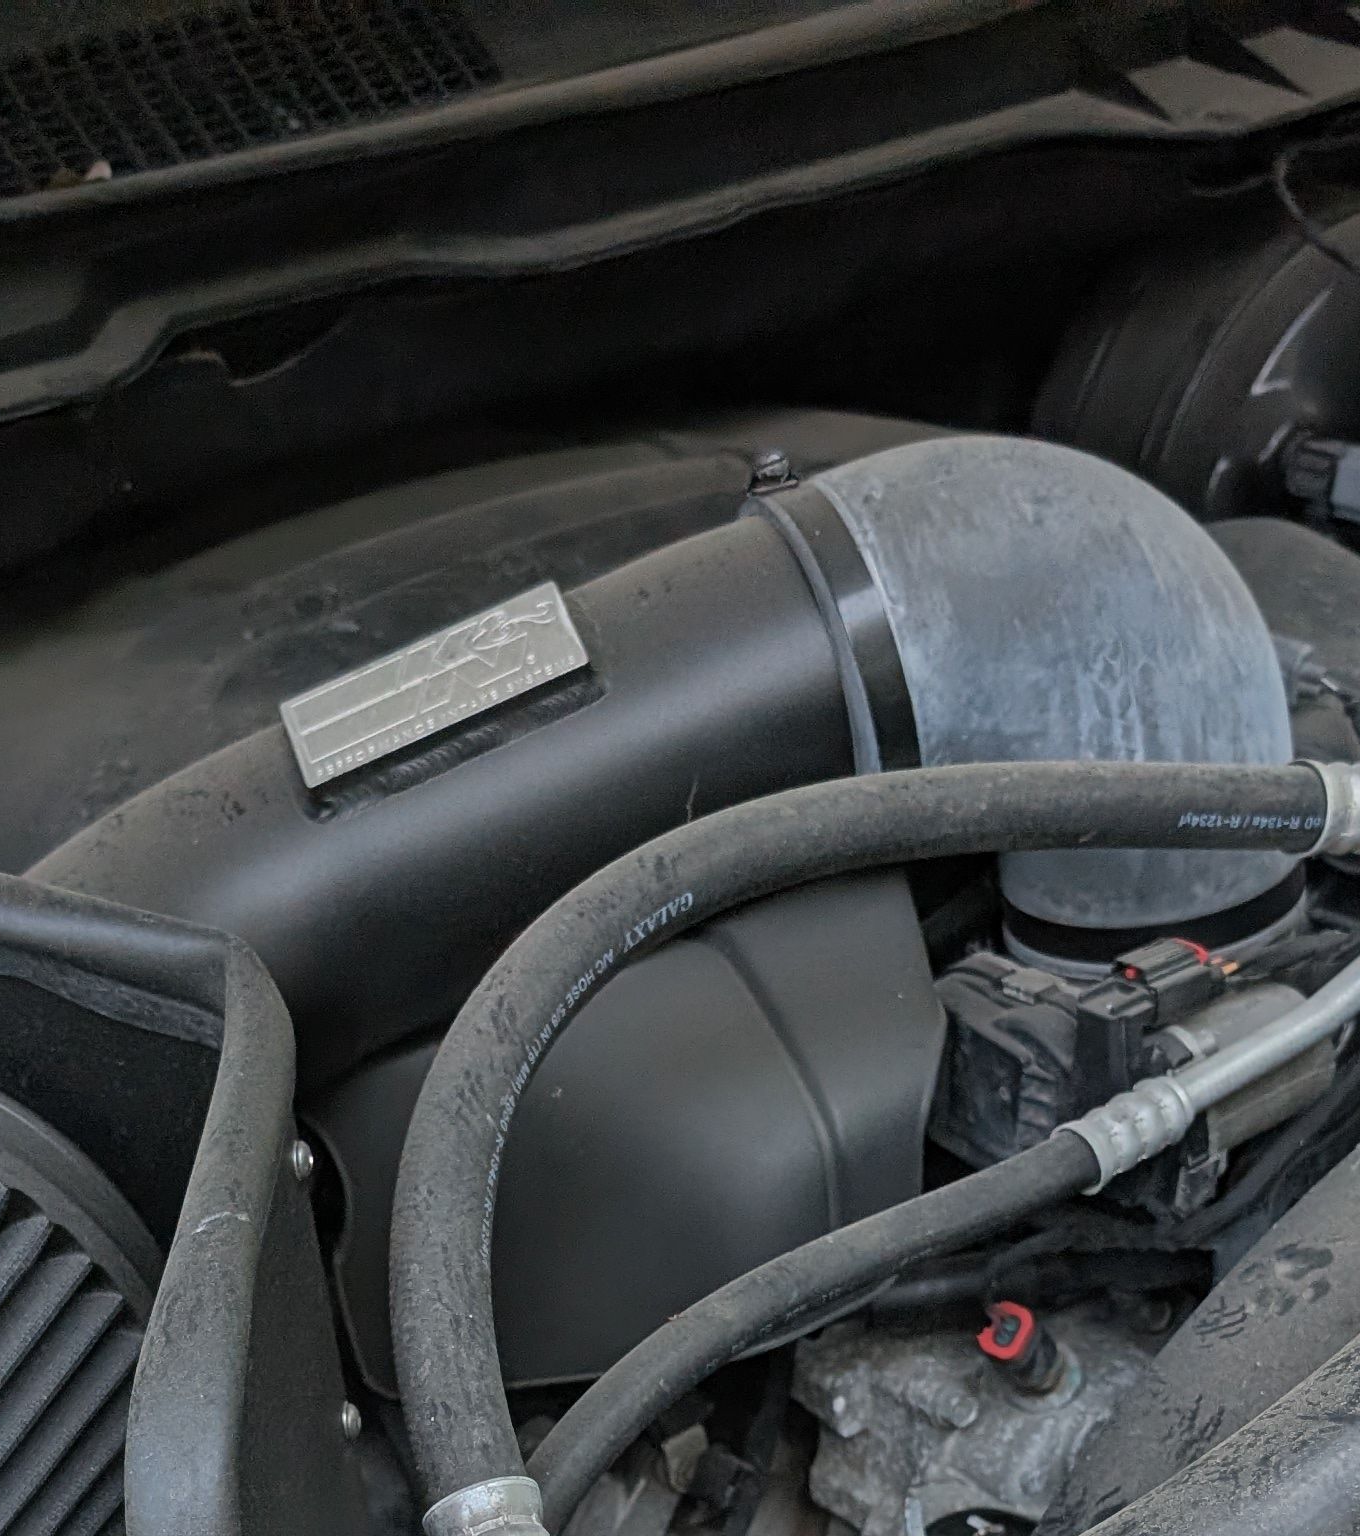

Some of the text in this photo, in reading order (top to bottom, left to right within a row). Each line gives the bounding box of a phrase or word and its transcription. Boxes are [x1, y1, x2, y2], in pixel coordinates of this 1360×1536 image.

[317, 655, 576, 777] PERFORMANCE INTAKE SYSTEMS
[623, 892, 694, 954] GALAXY
[595, 948, 614, 974] A/C
[565, 968, 596, 1009] HOSE
